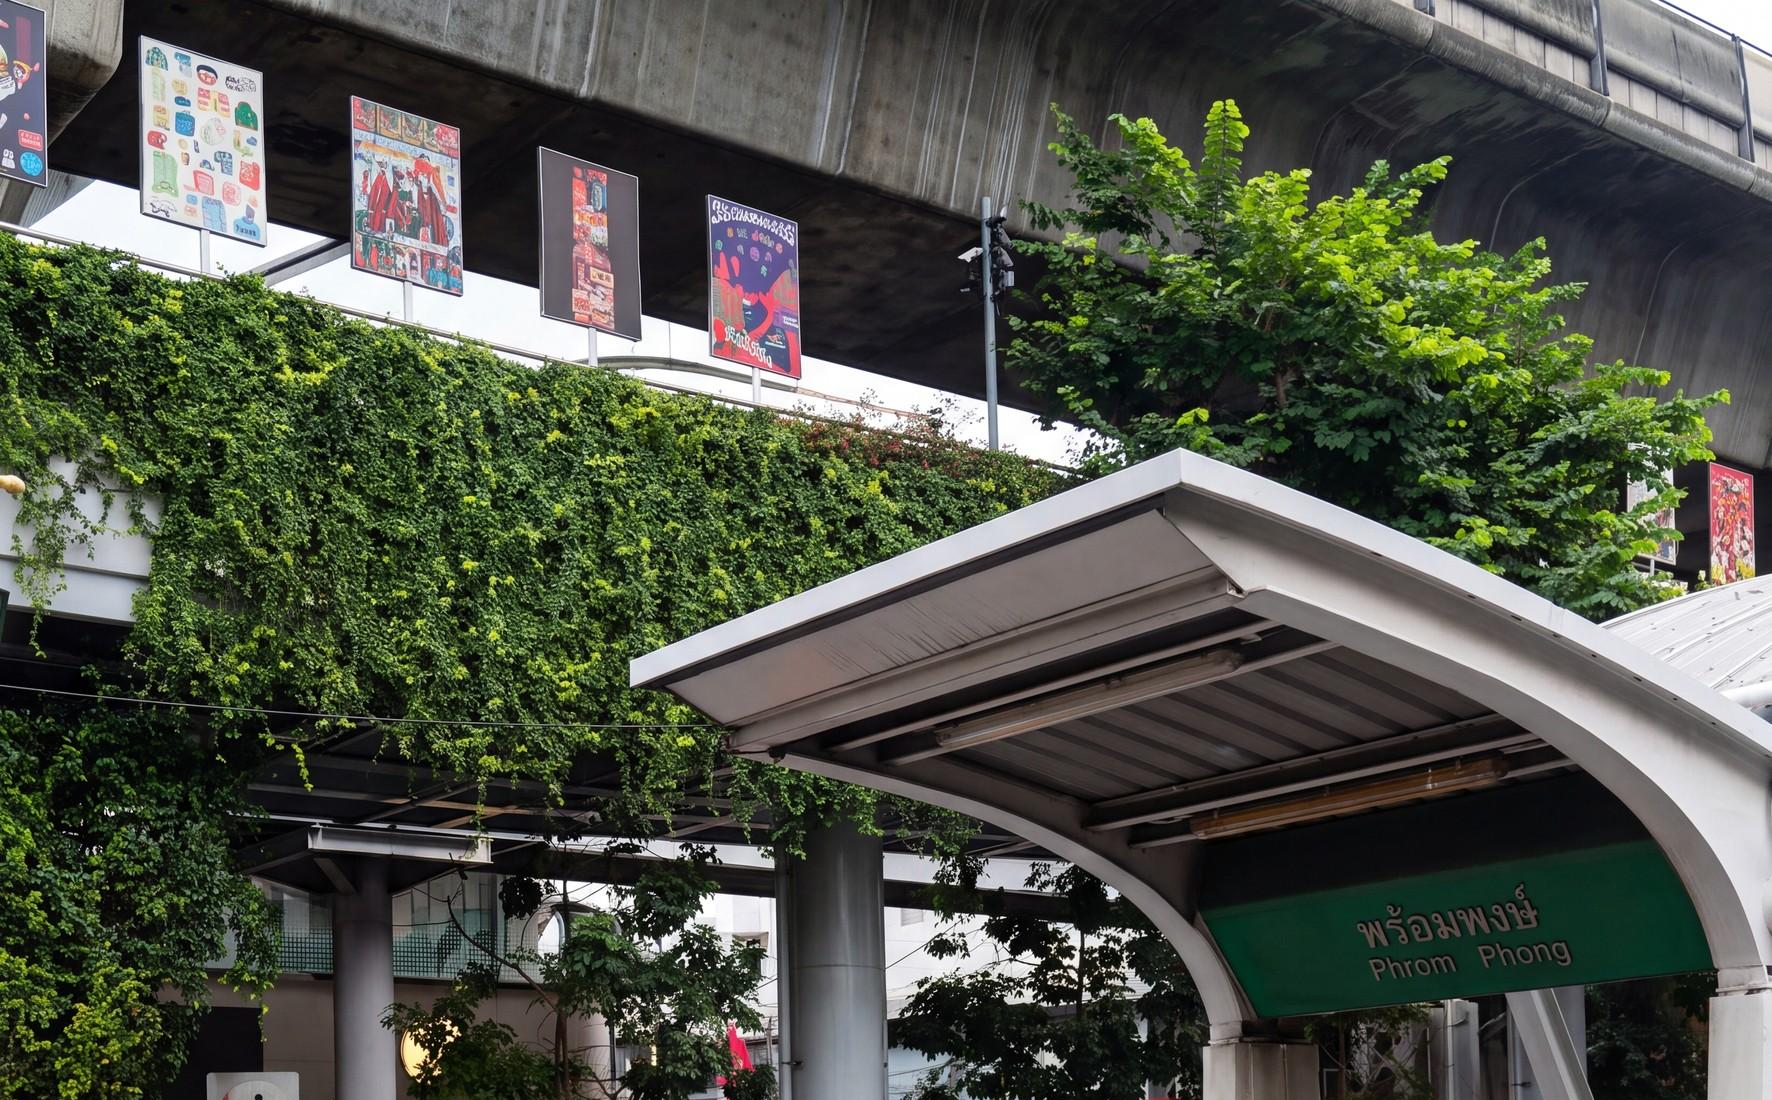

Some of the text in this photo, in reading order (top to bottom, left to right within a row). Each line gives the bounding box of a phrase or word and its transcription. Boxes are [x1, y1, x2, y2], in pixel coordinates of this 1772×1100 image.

[1357, 883, 1539, 949] พร้อมพงษ์
[1368, 940, 1573, 982] Phrom Phong
